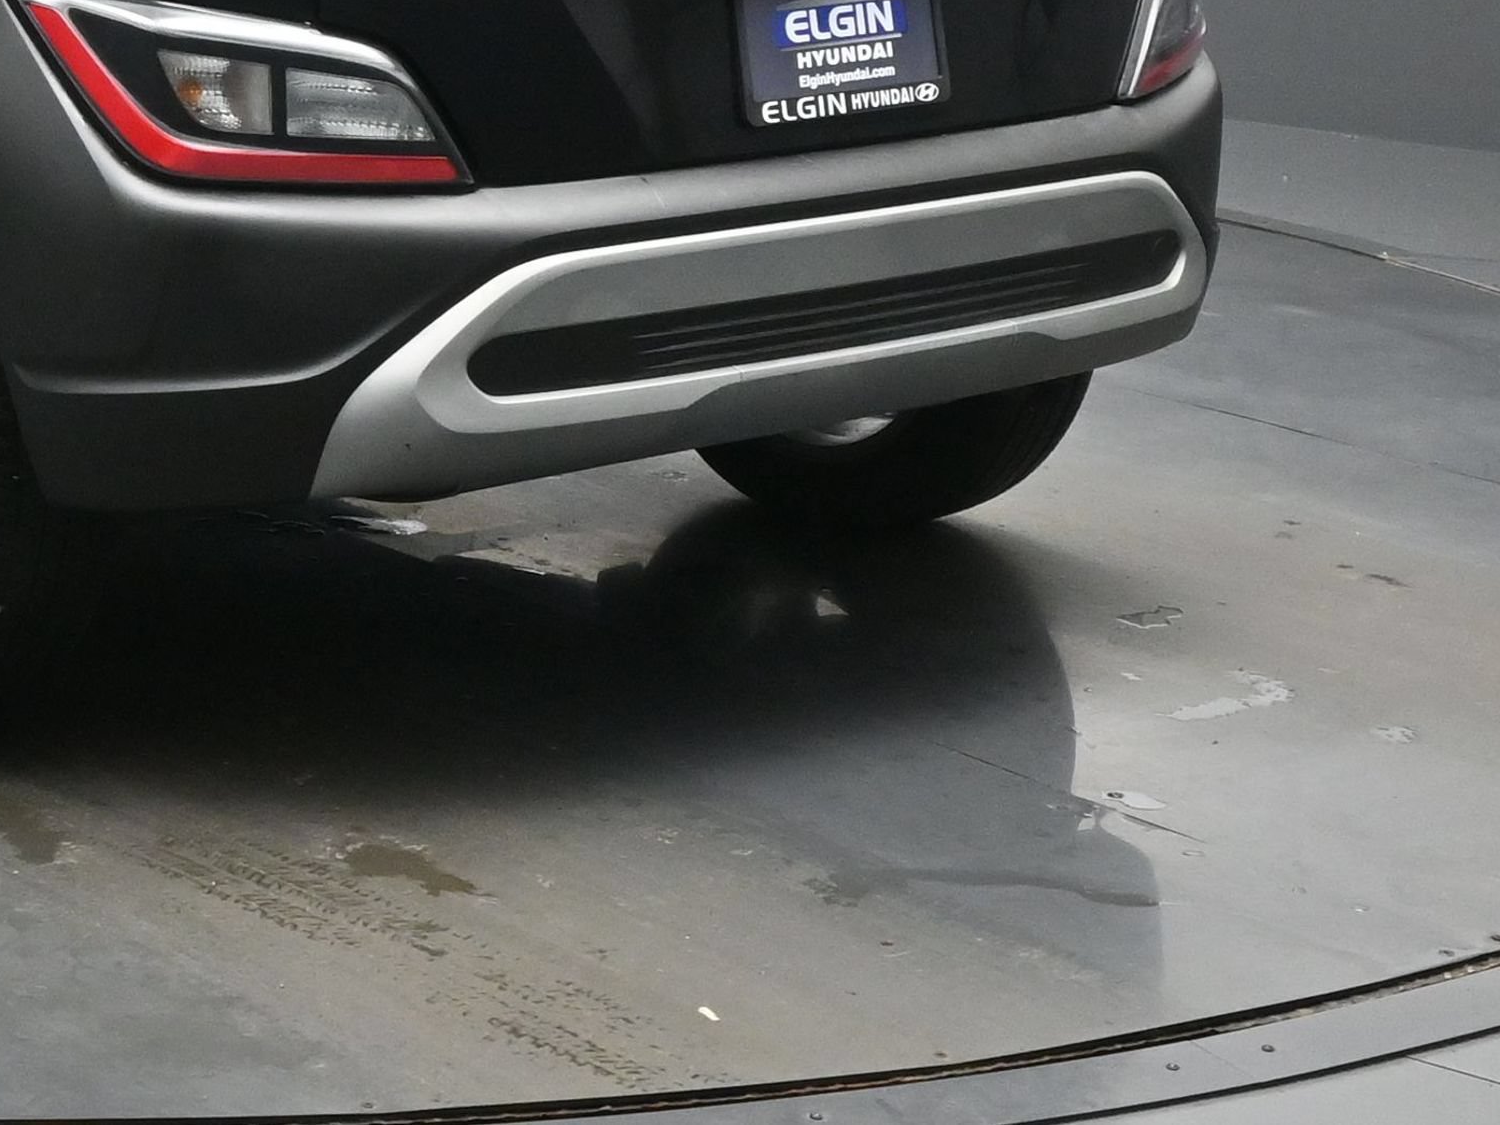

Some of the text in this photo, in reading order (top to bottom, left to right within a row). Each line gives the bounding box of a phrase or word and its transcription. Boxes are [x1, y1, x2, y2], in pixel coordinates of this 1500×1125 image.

[785, 0, 894, 43] ELGIN
[797, 41, 893, 69] HYUNDAI
[799, 66, 896, 89] ElginHyundai.com
[762, 86, 914, 124] ELGIN HYUNDAI
